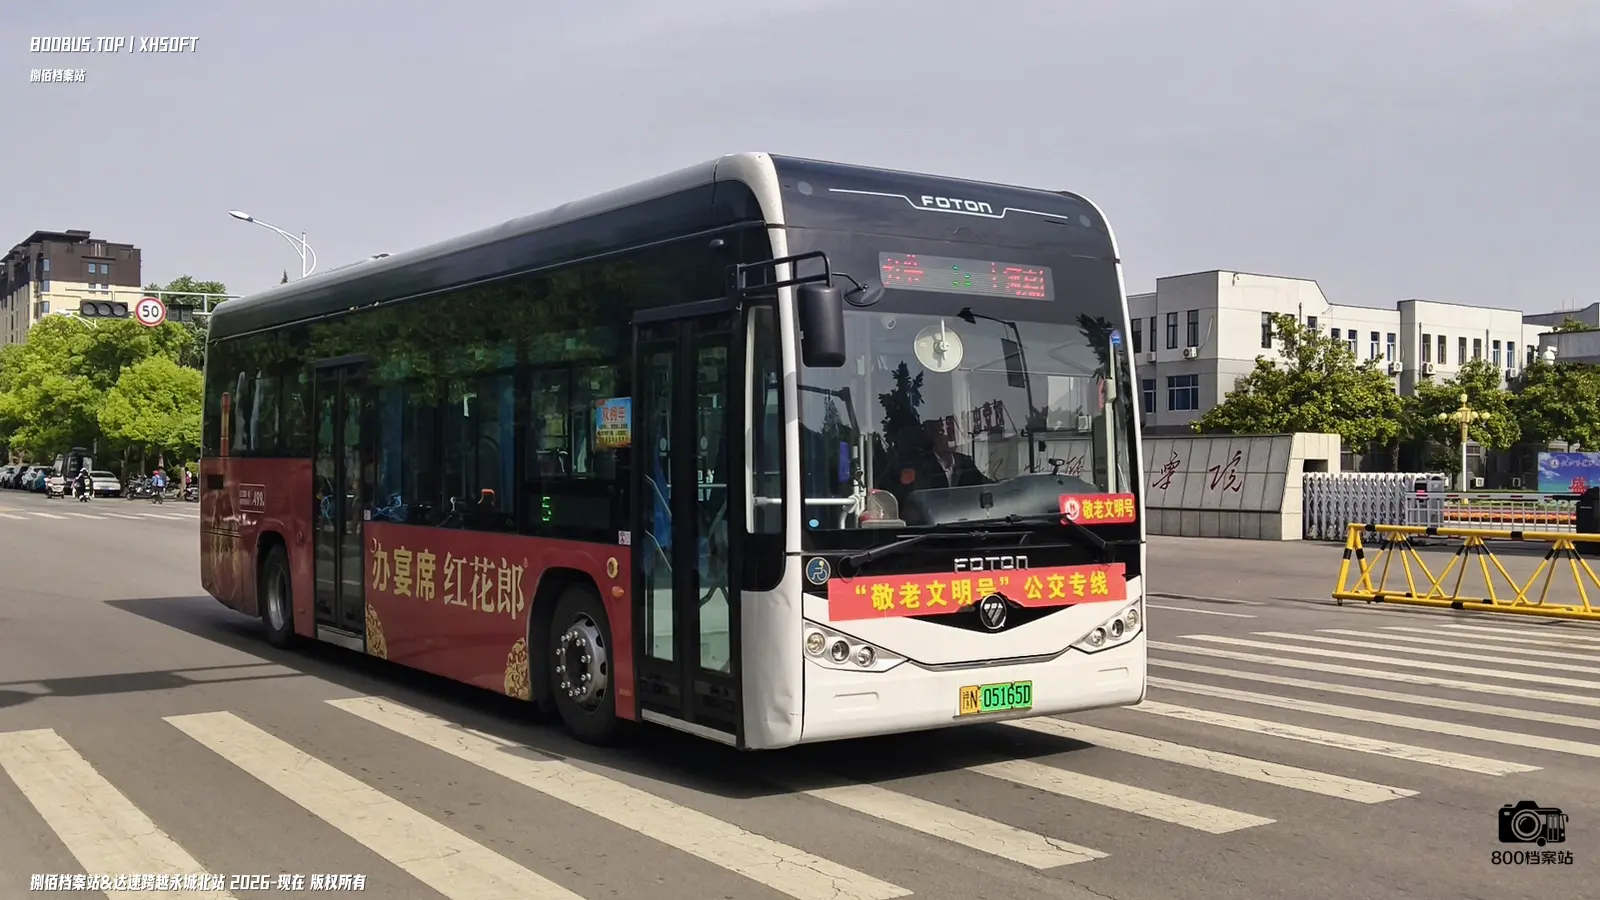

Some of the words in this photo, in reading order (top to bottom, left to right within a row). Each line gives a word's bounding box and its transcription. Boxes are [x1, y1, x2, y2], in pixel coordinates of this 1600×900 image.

[920, 195, 993, 214] FOTON
[142, 304, 160, 318] 50
[1081, 497, 1135, 519] 敬老文明号
[953, 555, 1029, 573] FOTON
[370, 538, 437, 601] 办宴席
[443, 551, 525, 620] 红花郎
[1024, 570, 1110, 601] 公交专线
